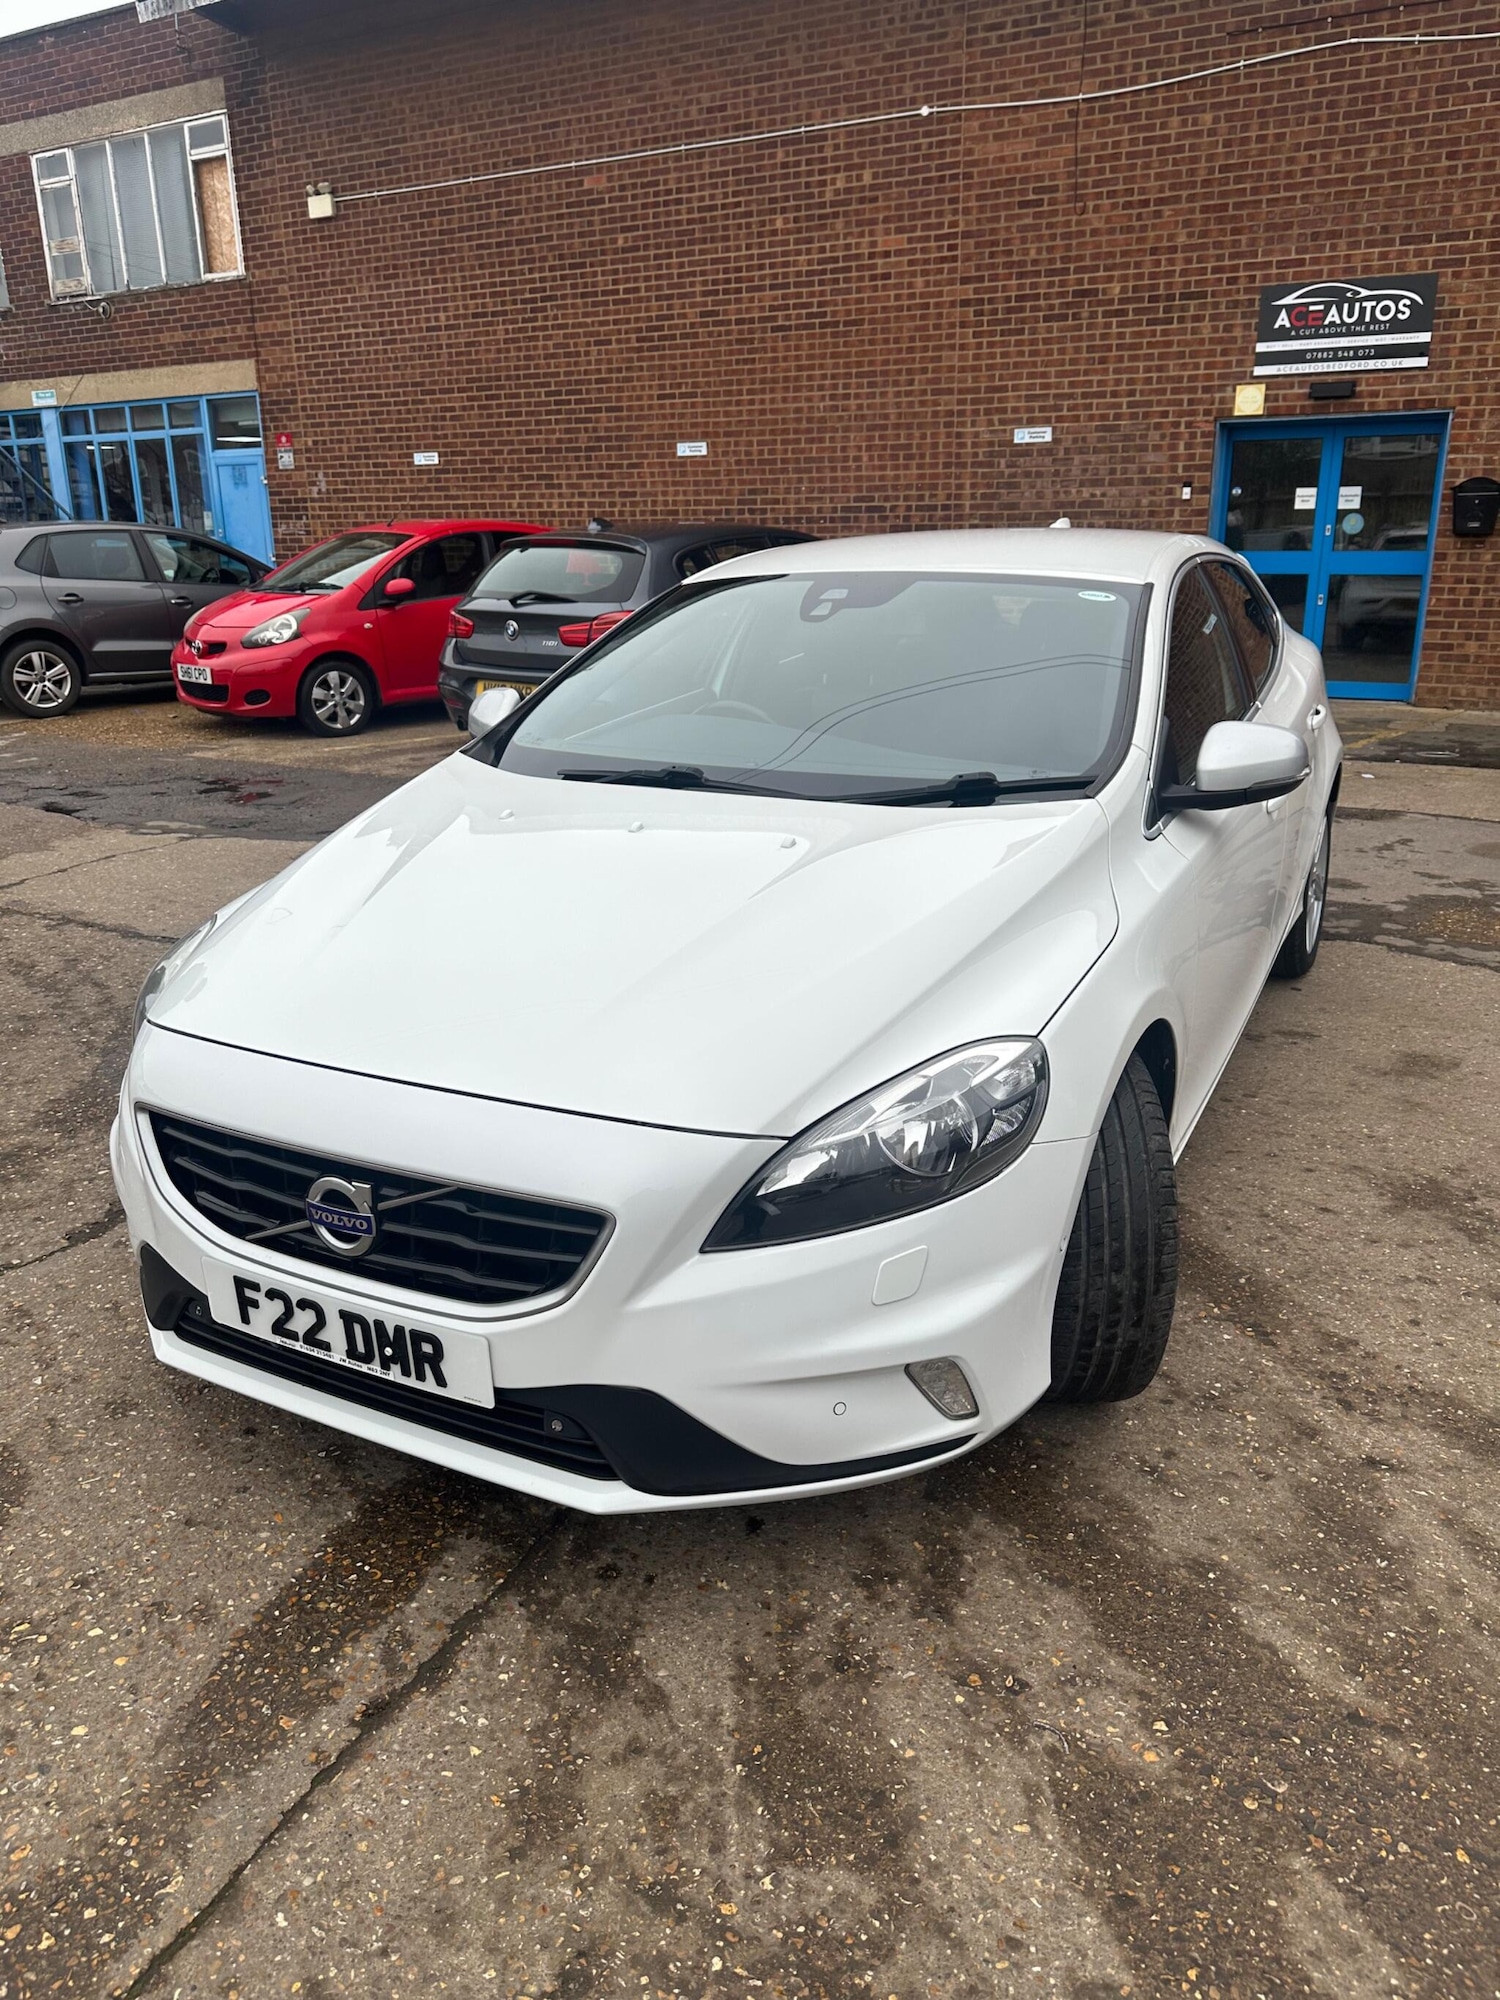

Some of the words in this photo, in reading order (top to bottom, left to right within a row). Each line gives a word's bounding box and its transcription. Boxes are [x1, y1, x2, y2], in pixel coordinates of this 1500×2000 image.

[1319, 326, 1347, 334] ABOVE
[1351, 324, 1366, 332] THE
[1369, 323, 1390, 331] REST
[1357, 348, 1375, 356] 073
[1276, 360, 1404, 372] ACEAUTOSBEDFORD.CO.UK
[309, 1207, 369, 1231] VOLVO
[233, 1274, 332, 1353] F22
[338, 1308, 448, 1388] DMR
